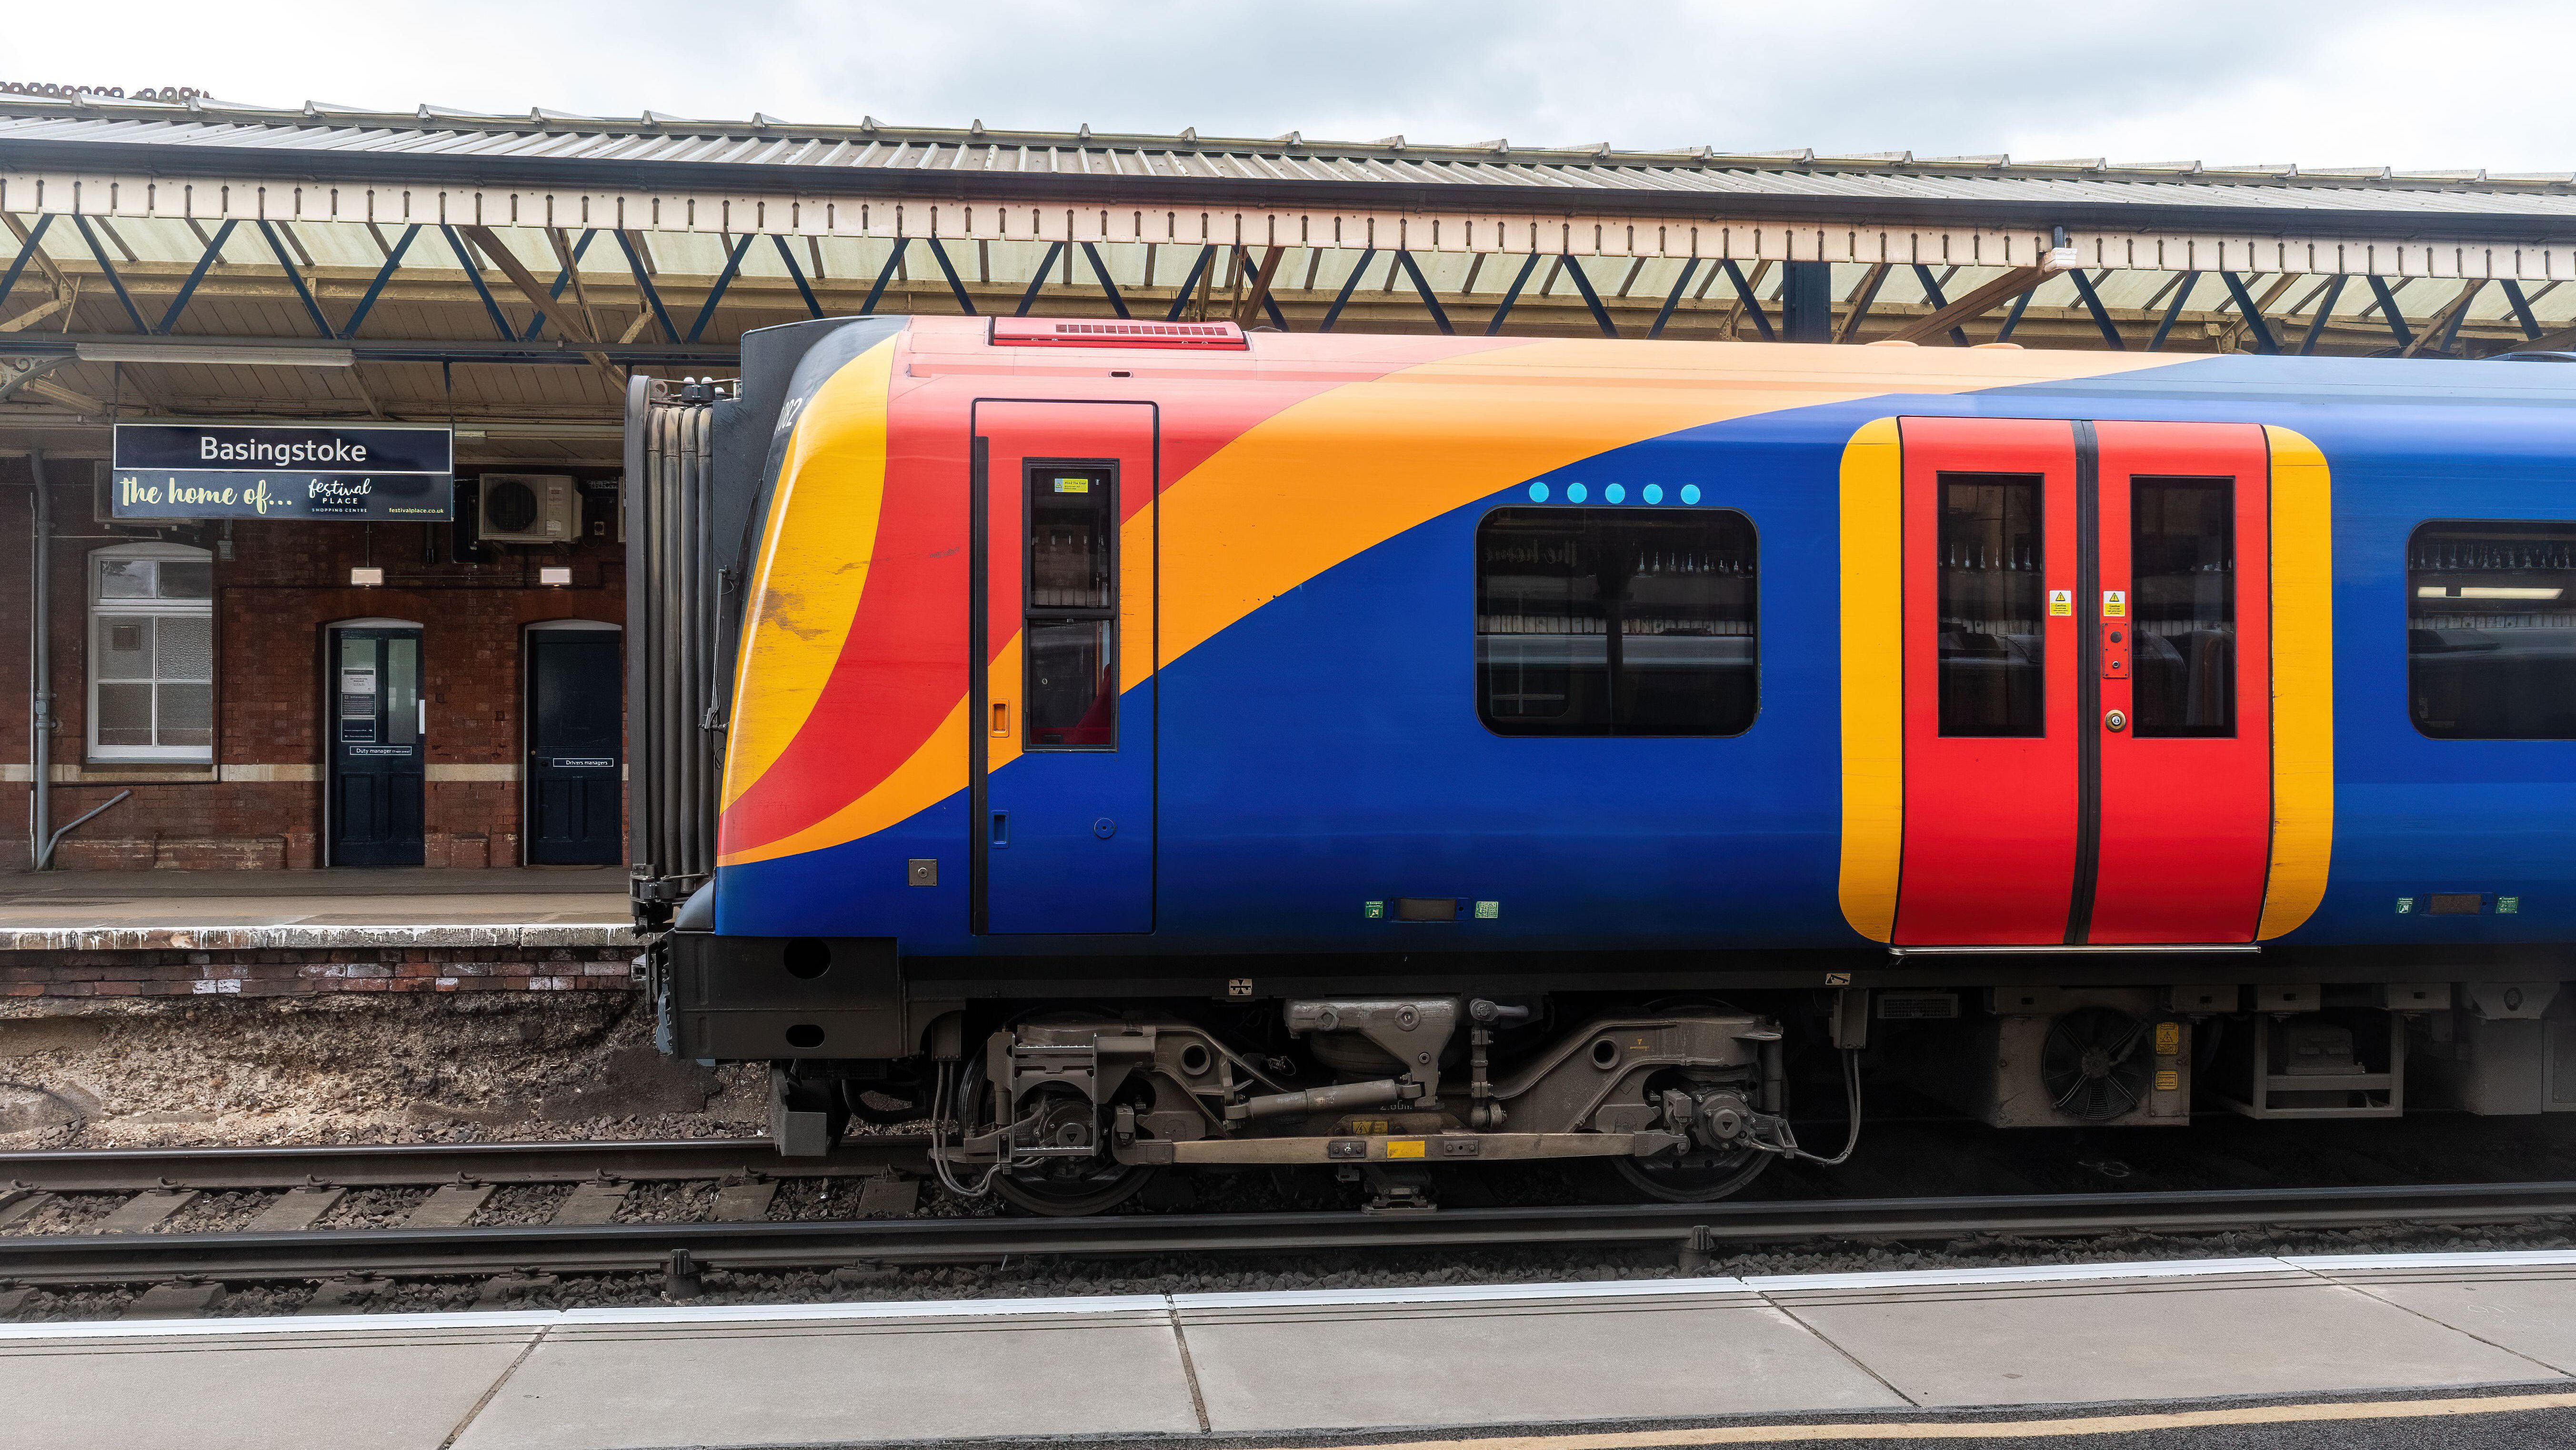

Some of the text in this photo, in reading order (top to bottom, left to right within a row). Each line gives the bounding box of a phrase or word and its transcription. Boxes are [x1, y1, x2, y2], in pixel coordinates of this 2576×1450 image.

[201, 436, 367, 466] Basingstoke
[169, 477, 238, 505] home
[309, 478, 371, 498] festival
